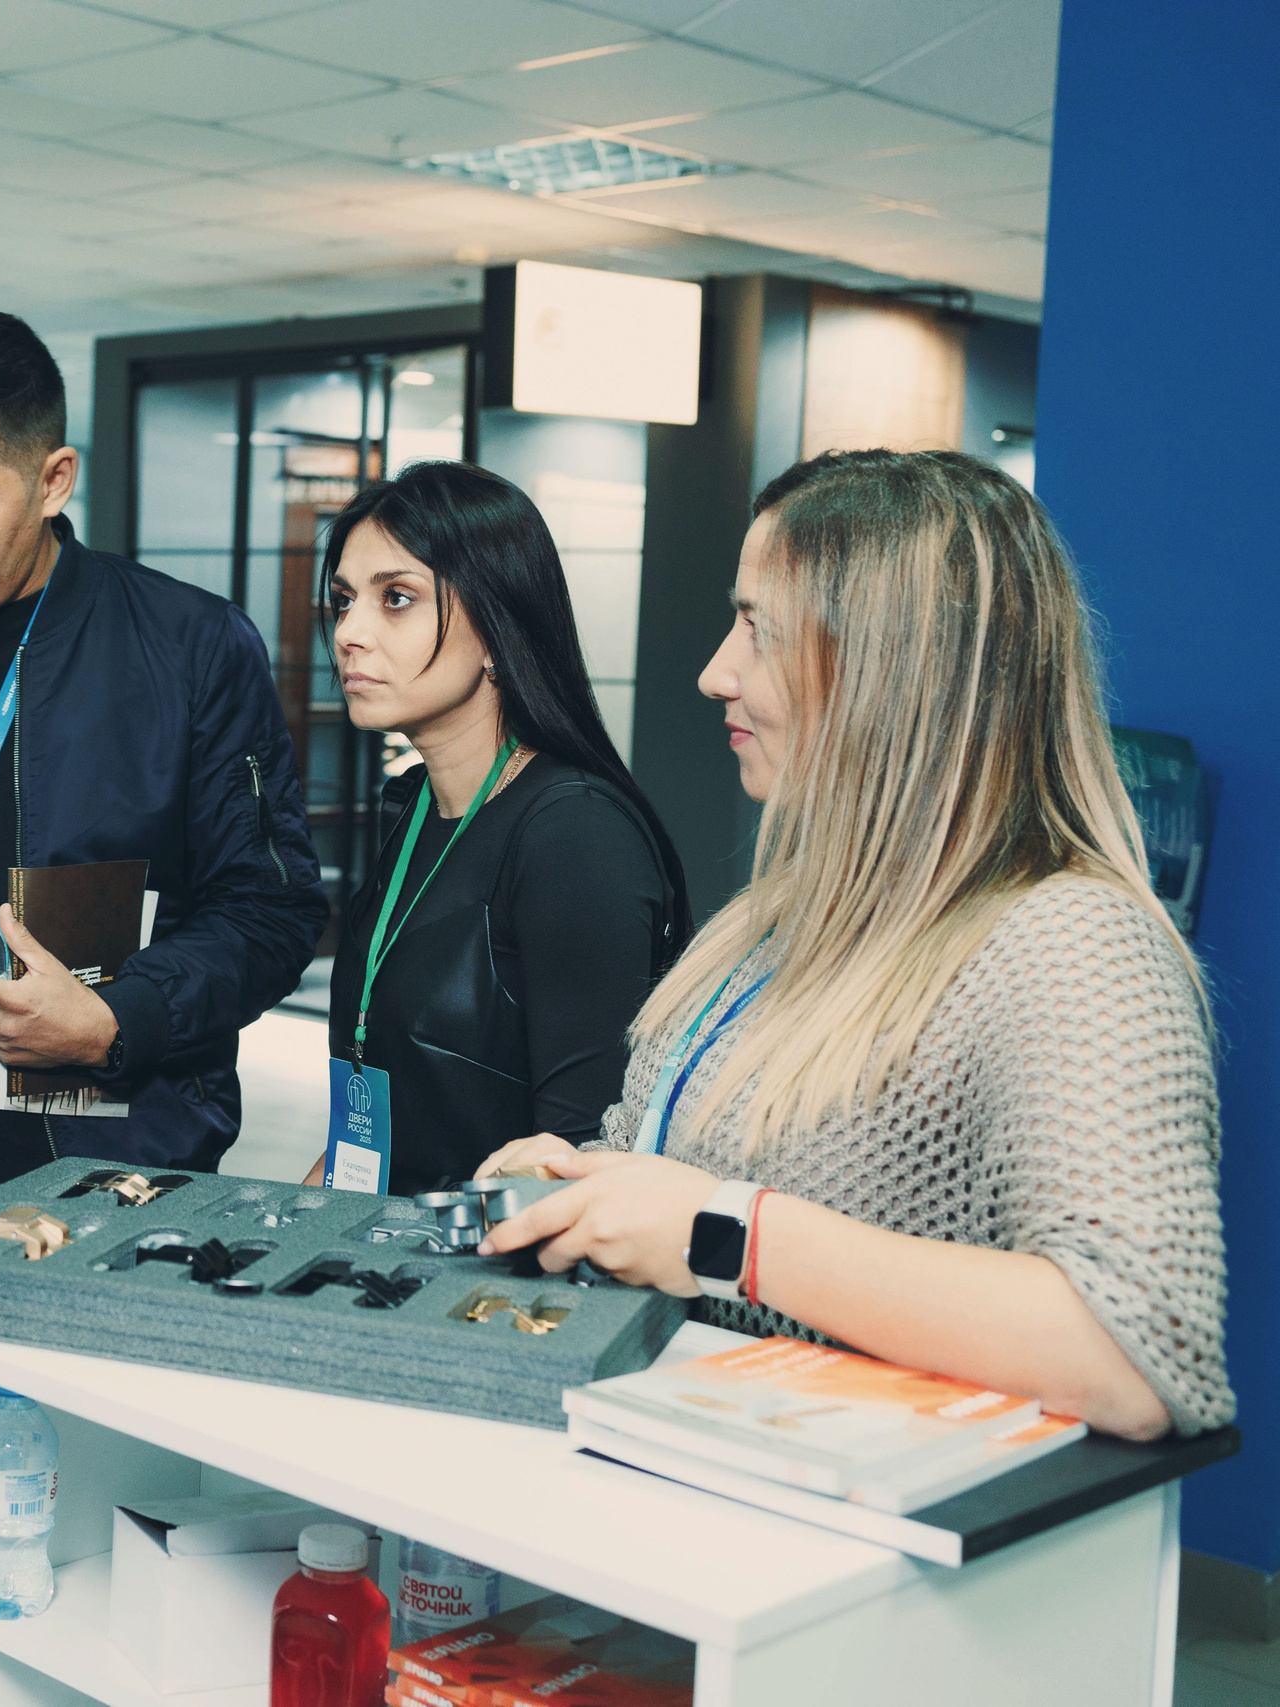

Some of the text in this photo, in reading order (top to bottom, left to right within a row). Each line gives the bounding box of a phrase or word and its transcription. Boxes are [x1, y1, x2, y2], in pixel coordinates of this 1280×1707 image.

[348, 1112, 372, 1127] ДВЕРИ
[348, 1123, 372, 1136] РОССИИ
[359, 1135, 372, 1144] 2025
